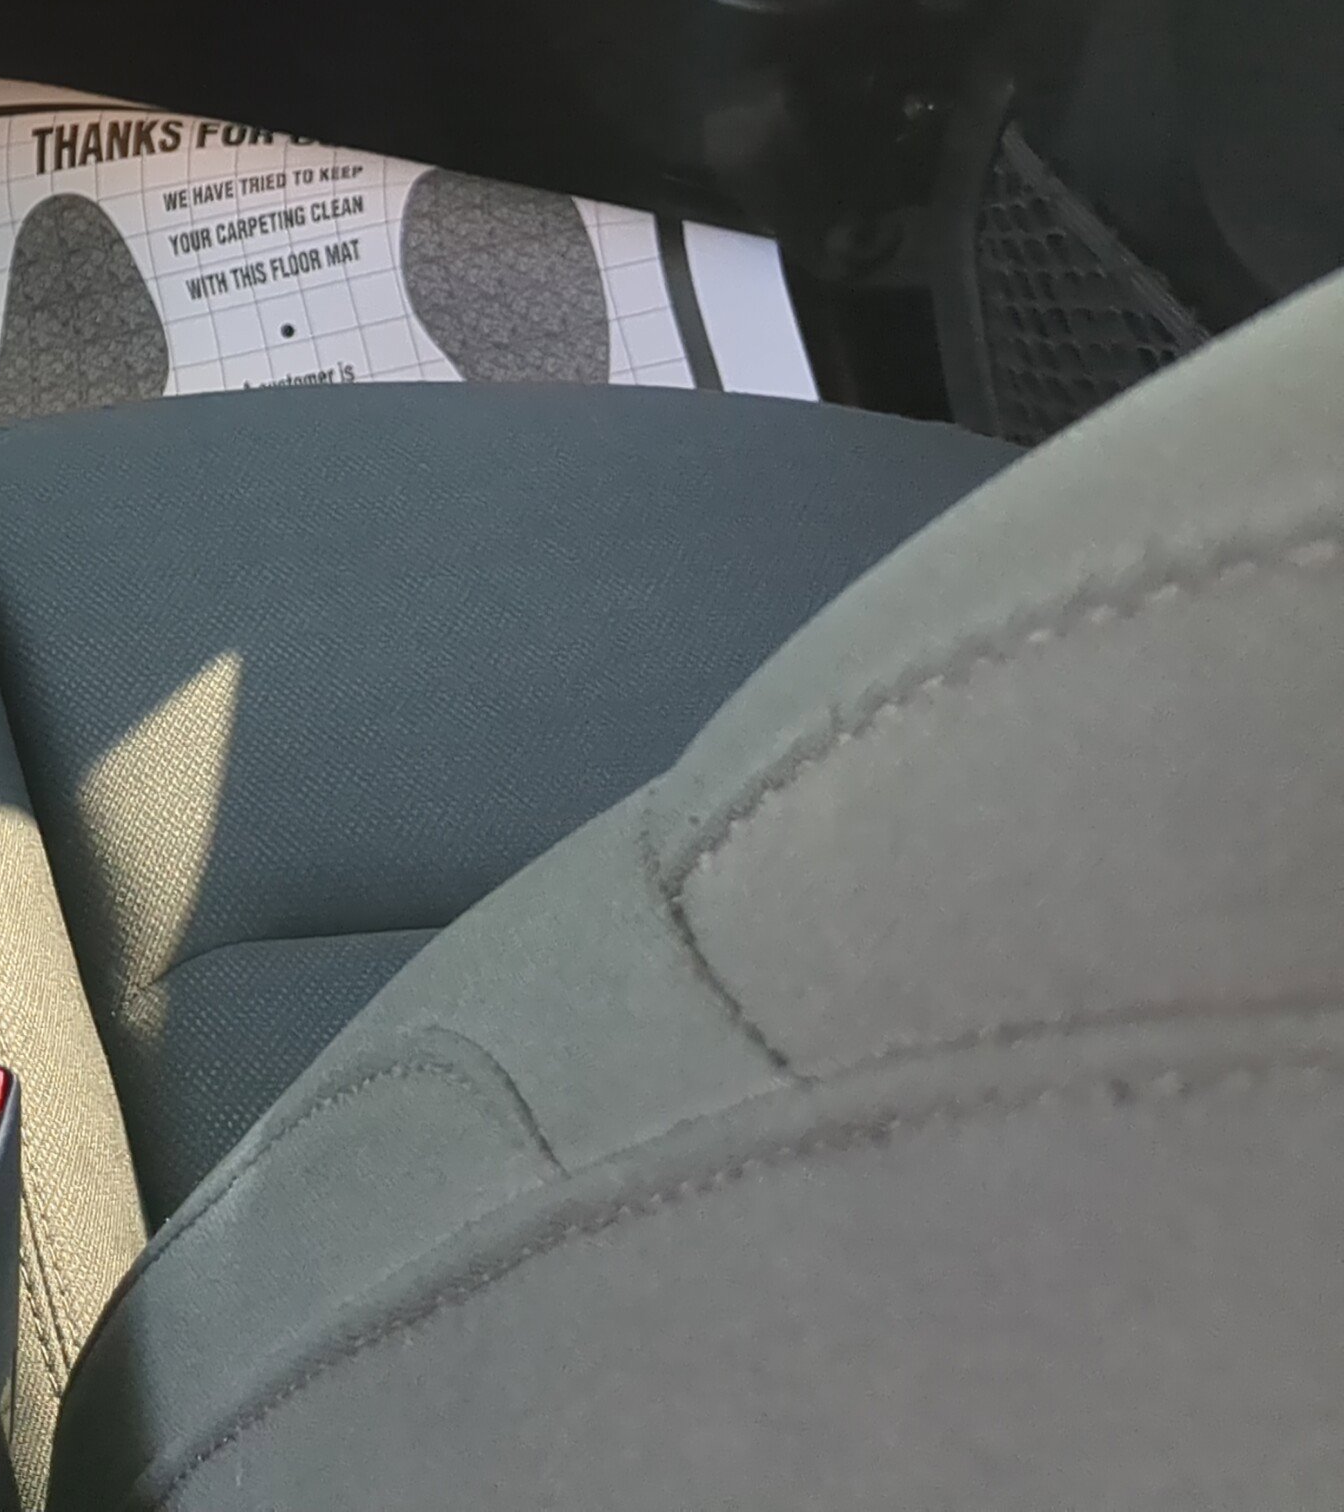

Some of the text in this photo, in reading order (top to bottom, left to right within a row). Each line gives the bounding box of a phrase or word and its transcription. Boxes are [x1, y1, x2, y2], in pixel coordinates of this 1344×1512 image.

[31, 120, 184, 175] THANKS
[163, 165, 364, 212] WE HAVE TRIED TO KEEP
[168, 195, 364, 256] YOUR CARPETING CLEAN
[185, 239, 360, 301] WITH THIS FLOOR MAT
[262, 368, 334, 388] tomer
